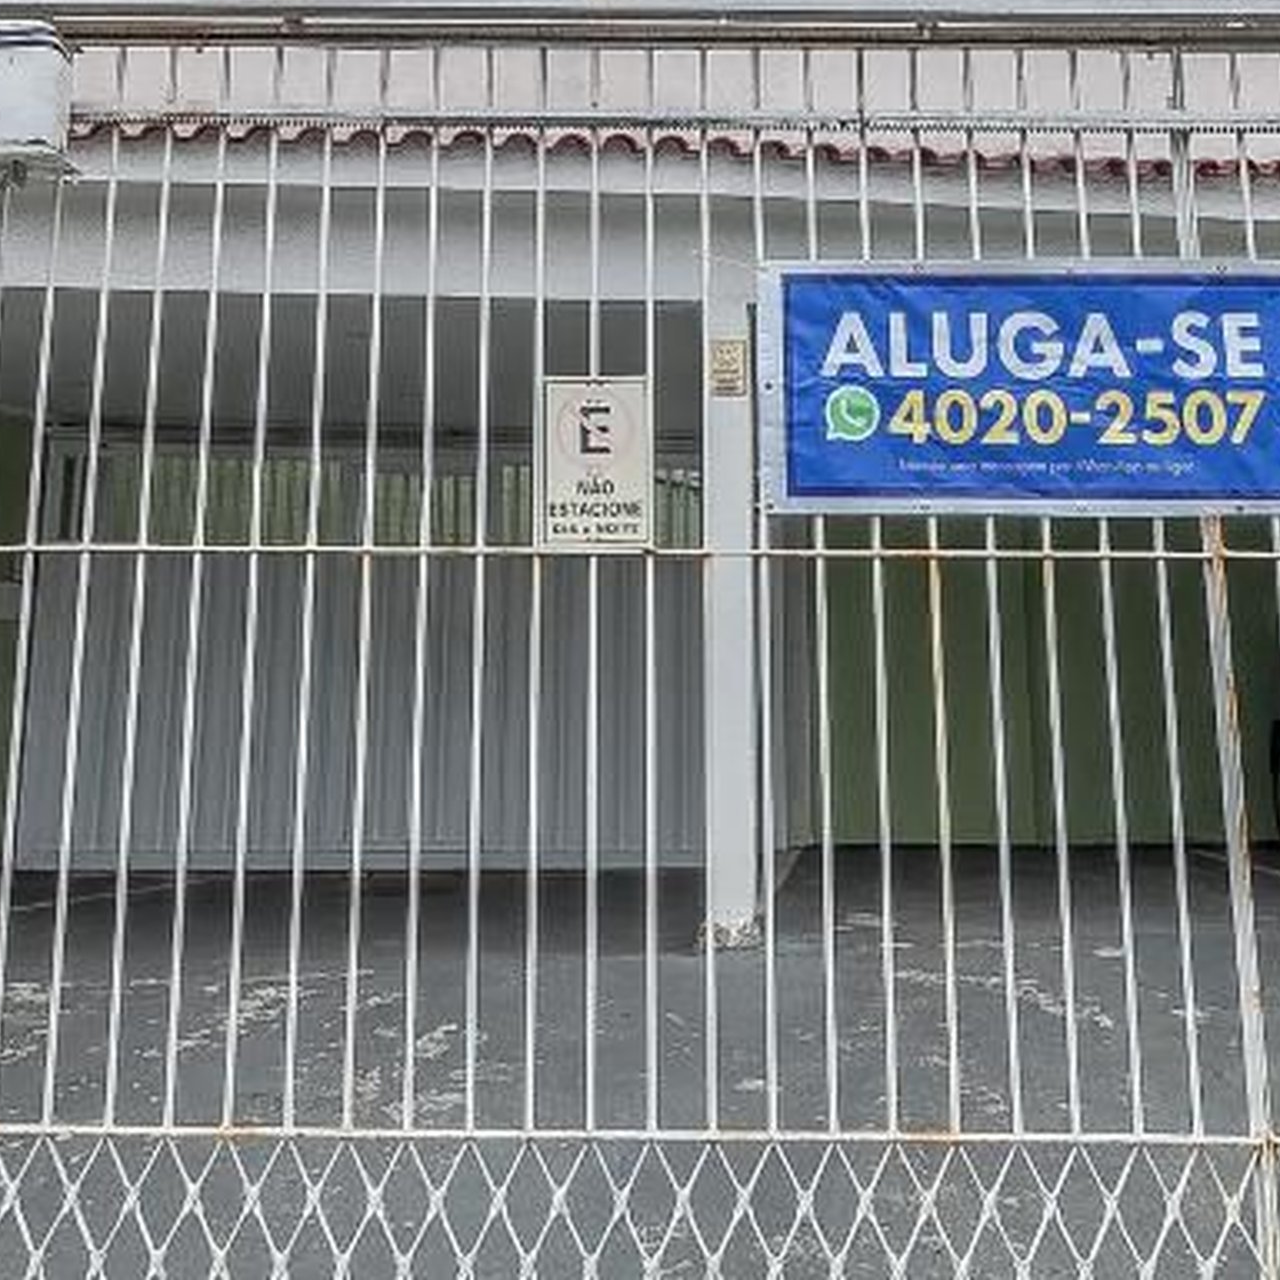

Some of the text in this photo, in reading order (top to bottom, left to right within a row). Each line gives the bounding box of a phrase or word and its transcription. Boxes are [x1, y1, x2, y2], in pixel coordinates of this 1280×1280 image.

[821, 312, 1266, 380] ALUGA-SE
[888, 389, 1267, 446] 4020-2507
[576, 476, 615, 495] NÃO
[549, 501, 642, 518] ESTACIONE
